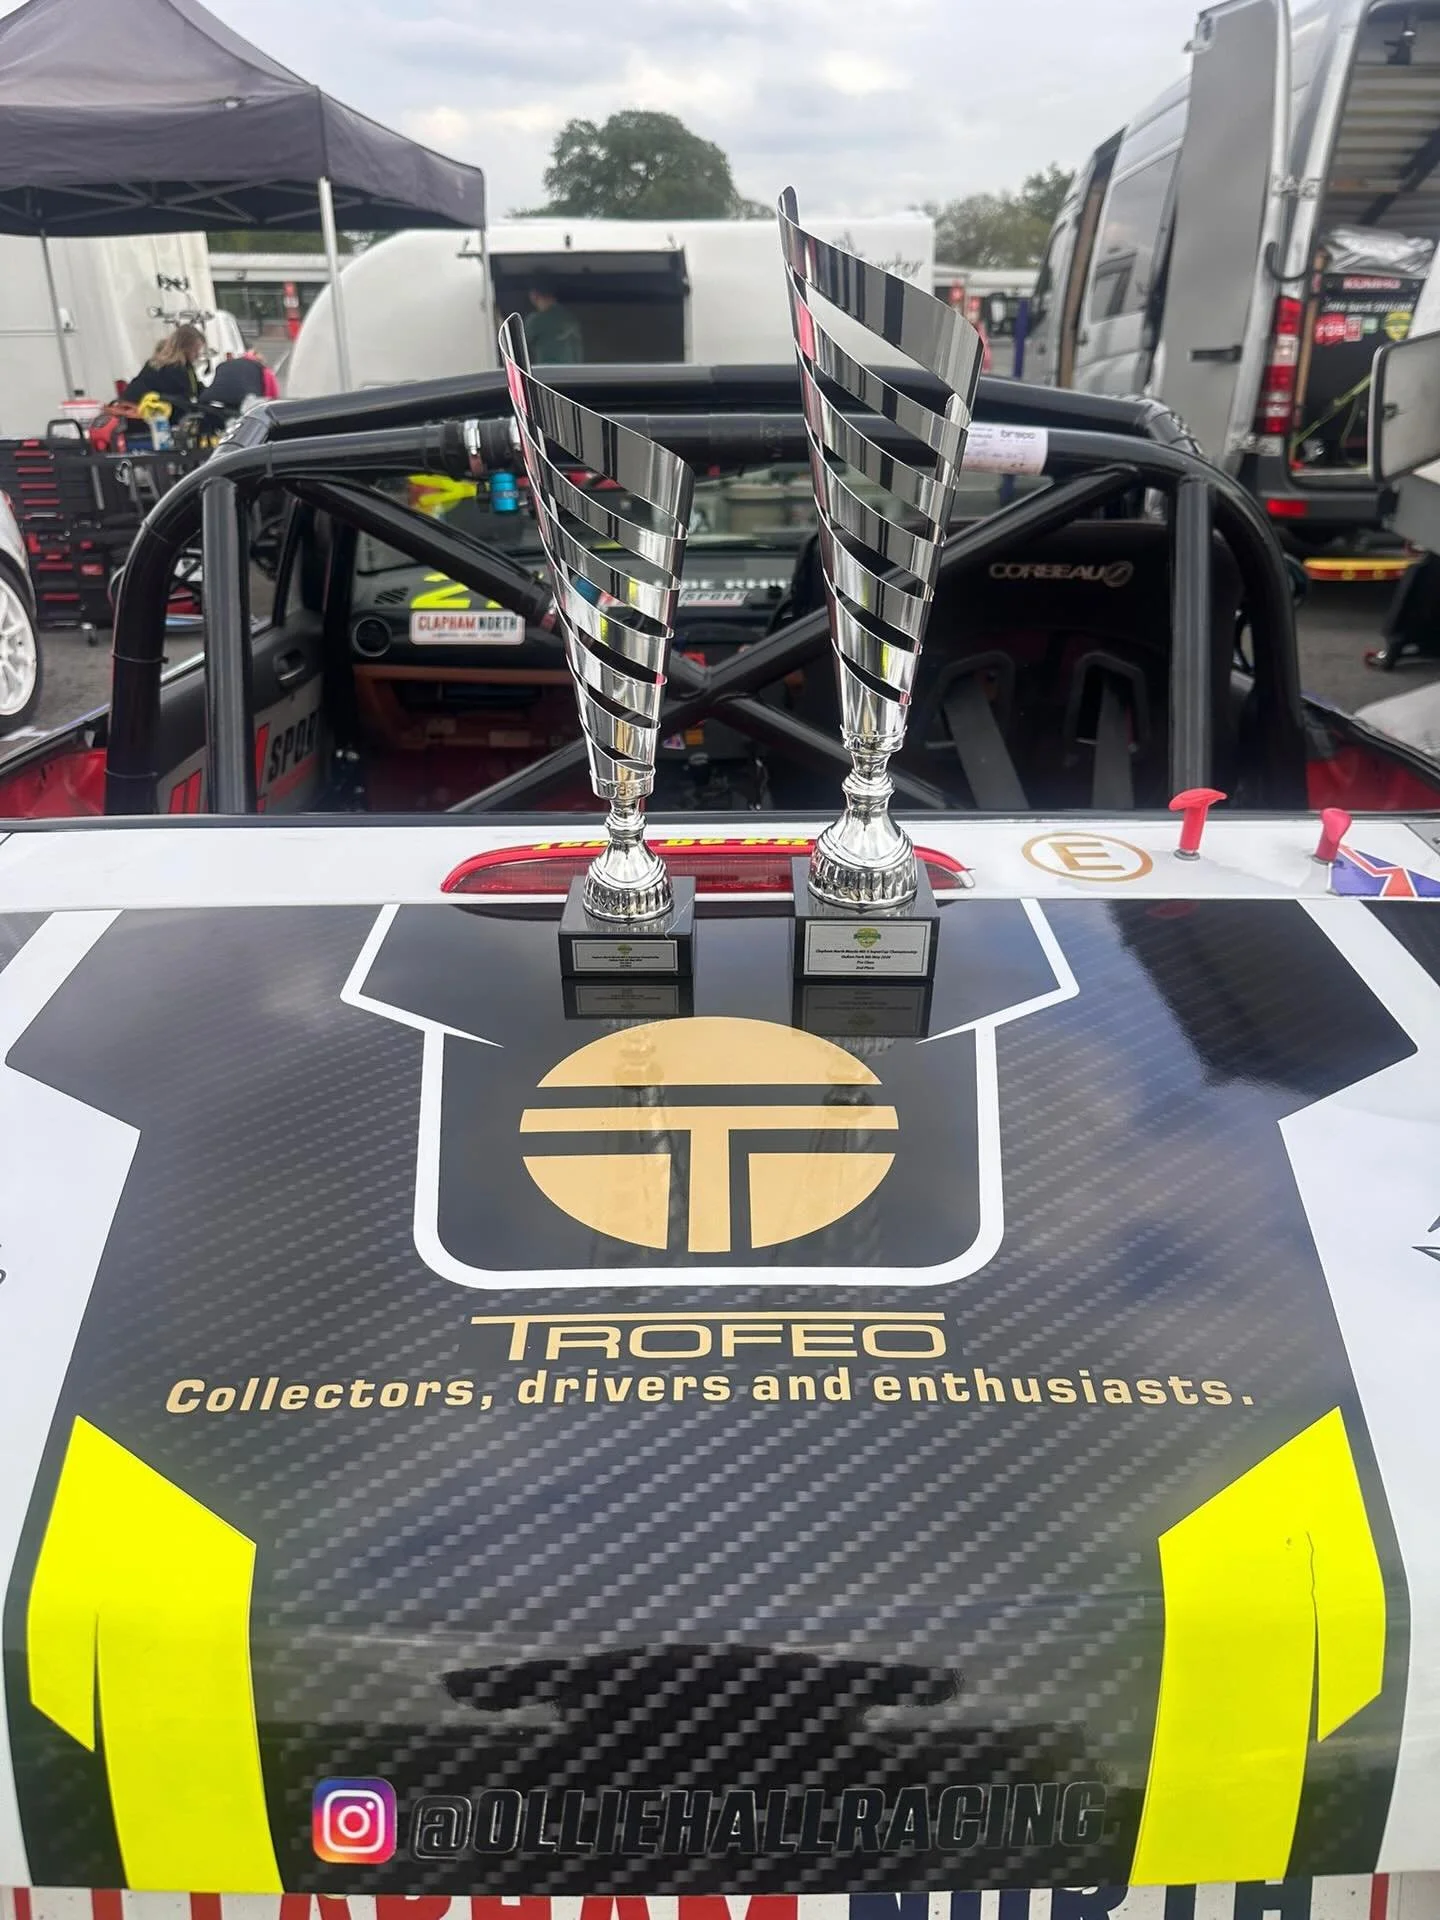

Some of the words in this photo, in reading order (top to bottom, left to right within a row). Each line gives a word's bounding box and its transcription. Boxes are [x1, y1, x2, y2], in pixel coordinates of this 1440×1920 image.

[989, 563, 1106, 580] CORBEAU
[418, 615, 476, 631] CLAPHAM
[478, 615, 518, 633] NORTH
[1047, 841, 1125, 872] E
[471, 1311, 946, 1360] TROFEO
[166, 1378, 492, 1413] Collectors,
[517, 1370, 731, 1404] drivers
[752, 1367, 851, 1401] and
[873, 1368, 1254, 1406] enthusiasts.
[410, 1782, 1106, 1860] @OLLIEHALLRACING
